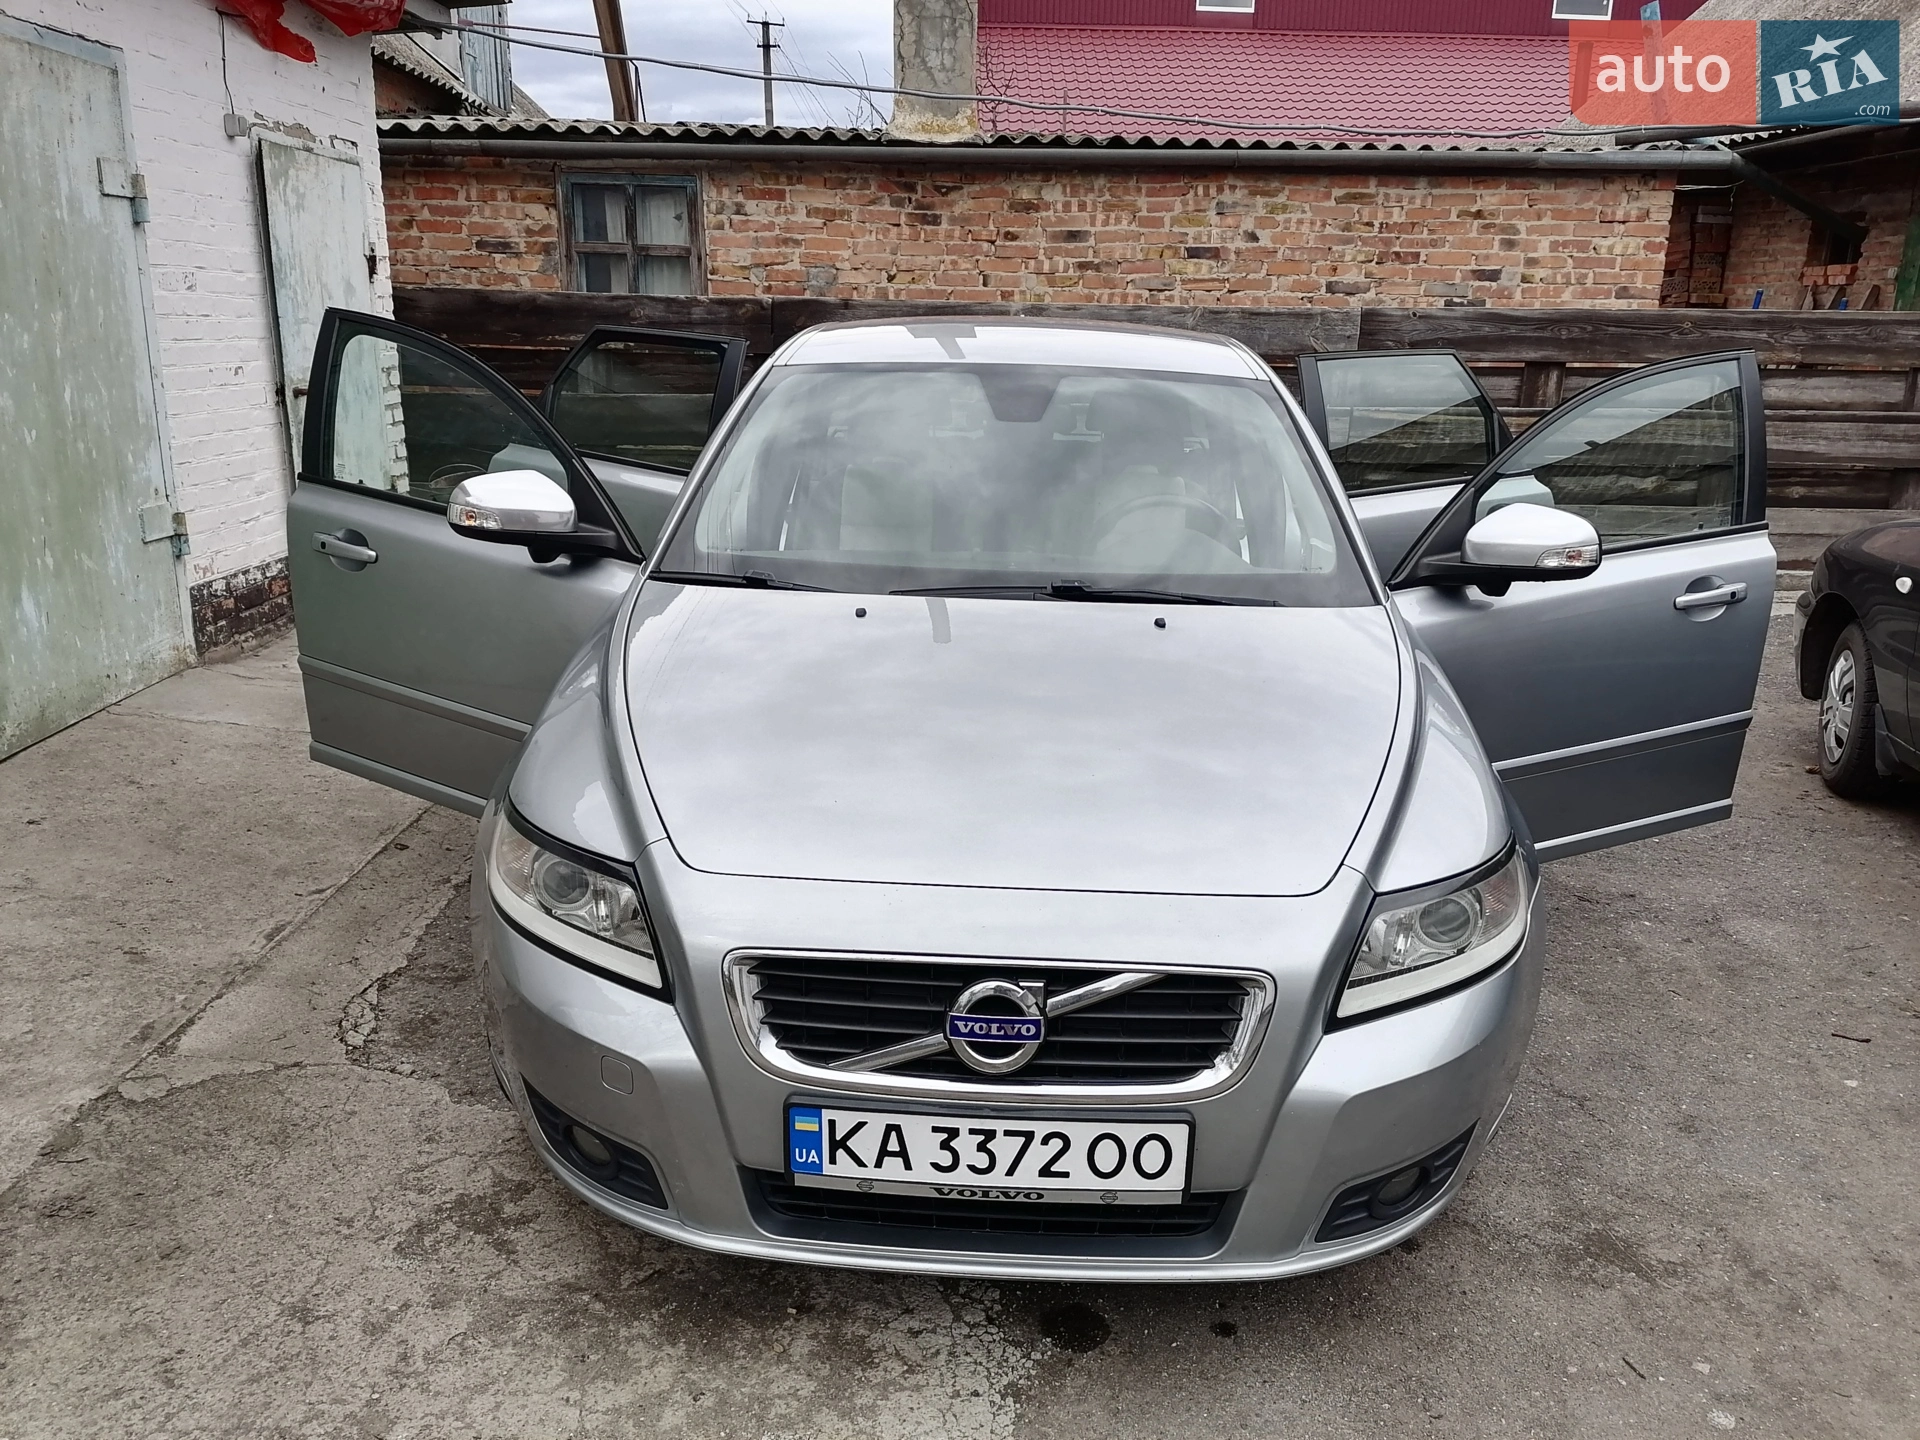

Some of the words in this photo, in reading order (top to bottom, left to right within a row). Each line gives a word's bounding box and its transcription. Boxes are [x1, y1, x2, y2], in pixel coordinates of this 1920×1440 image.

[954, 1020, 1037, 1036] VOLVO
[795, 1147, 820, 1164] UA
[827, 1118, 913, 1171] KA
[929, 1126, 1072, 1179] 3372
[929, 1186, 1045, 1201] VOLVO
